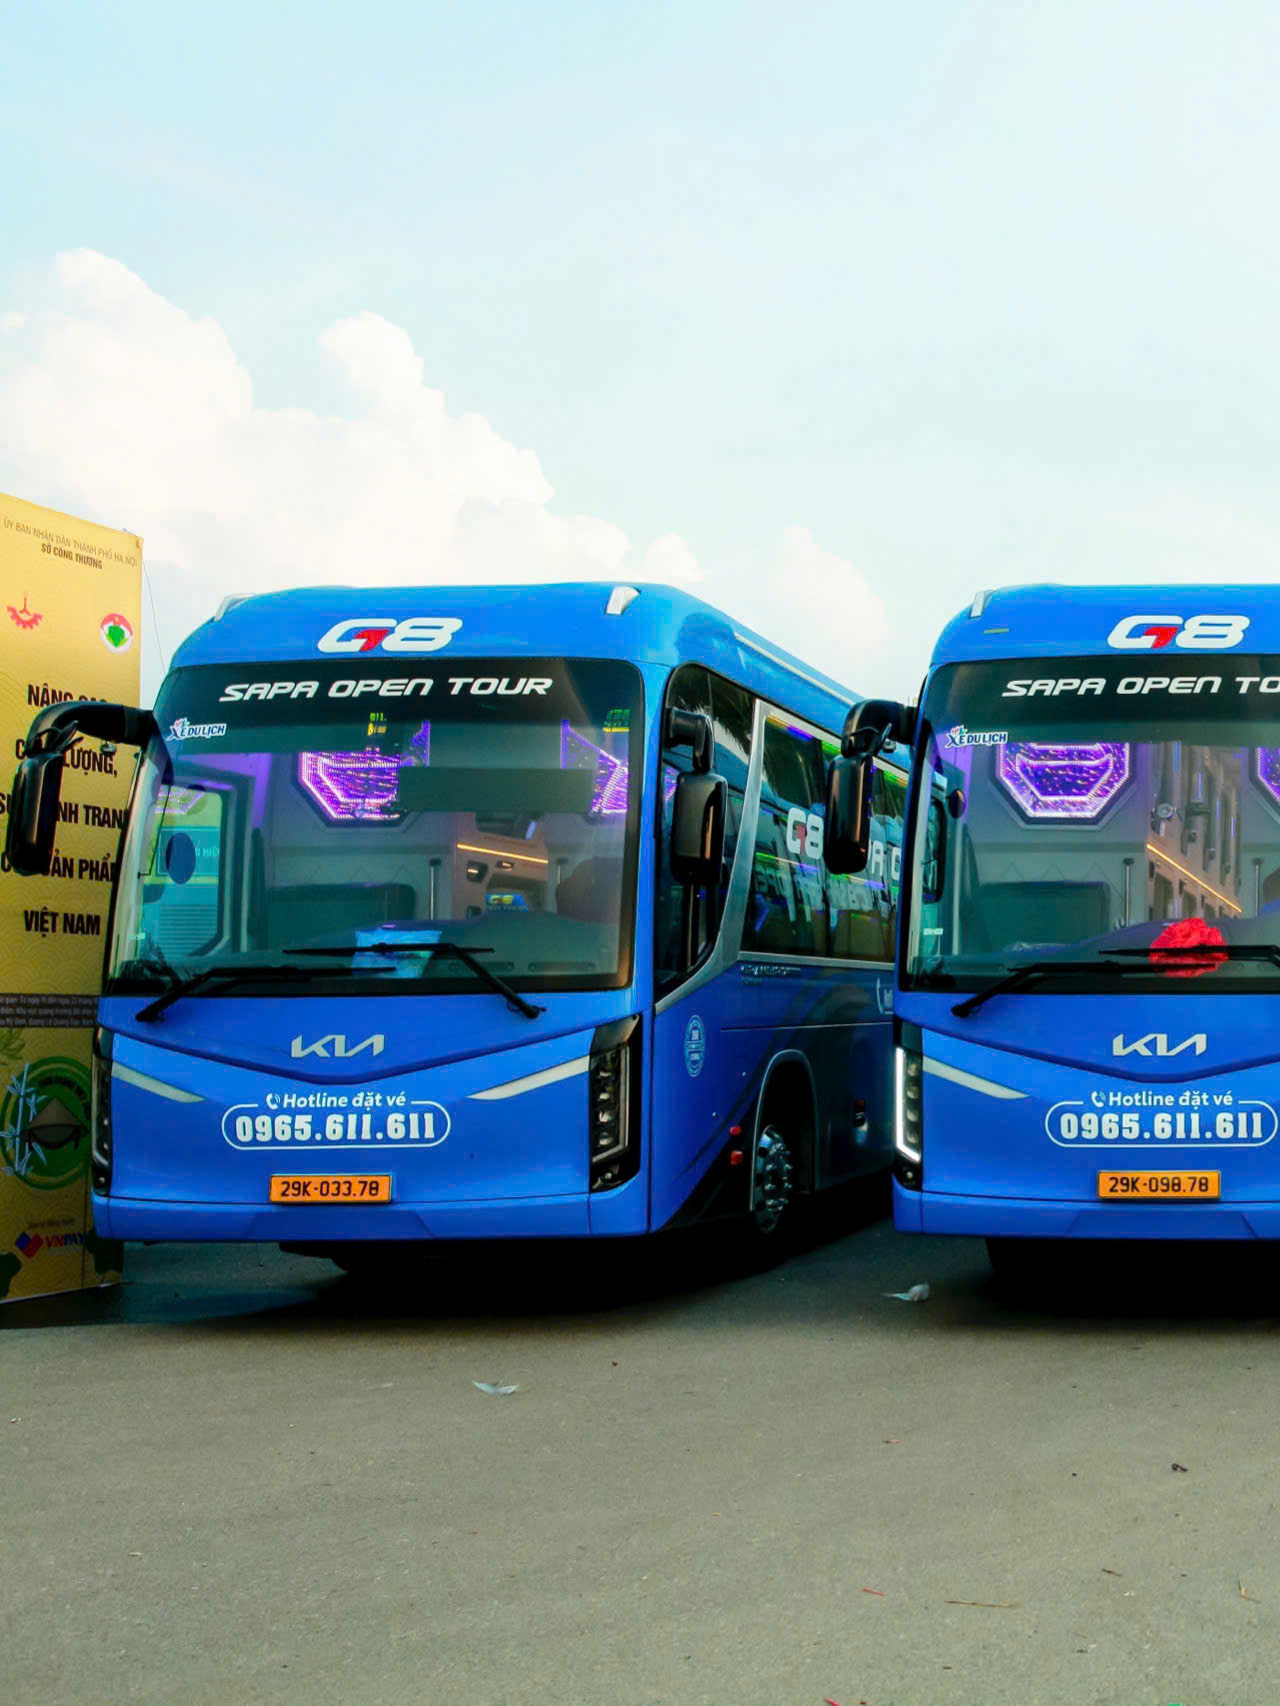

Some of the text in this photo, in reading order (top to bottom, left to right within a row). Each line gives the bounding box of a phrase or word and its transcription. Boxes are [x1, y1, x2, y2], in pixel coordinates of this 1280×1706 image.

[317, 617, 463, 653] G8
[1107, 615, 1251, 649] G8
[219, 677, 554, 702] SAPA OPEN TOUR
[1001, 677, 1107, 697] SAPA
[1116, 676, 1222, 694] OPEN
[945, 733, 965, 748] XE
[966, 733, 981, 744] DU
[787, 807, 824, 860] G8
[24, 906, 100, 938] VIỆT NAM
[291, 1034, 385, 1058] KIA
[1112, 1033, 1207, 1057] KIA
[283, 1091, 406, 1112] Hotline đặt vé
[1109, 1090, 1233, 1111] Hotline đặt vé
[235, 1112, 435, 1142] 0965.611.611
[1060, 1112, 1263, 1140] 0965.611.611
[280, 1180, 380, 1198] 29K-033.78
[1108, 1176, 1209, 1194] 29K-098.78
